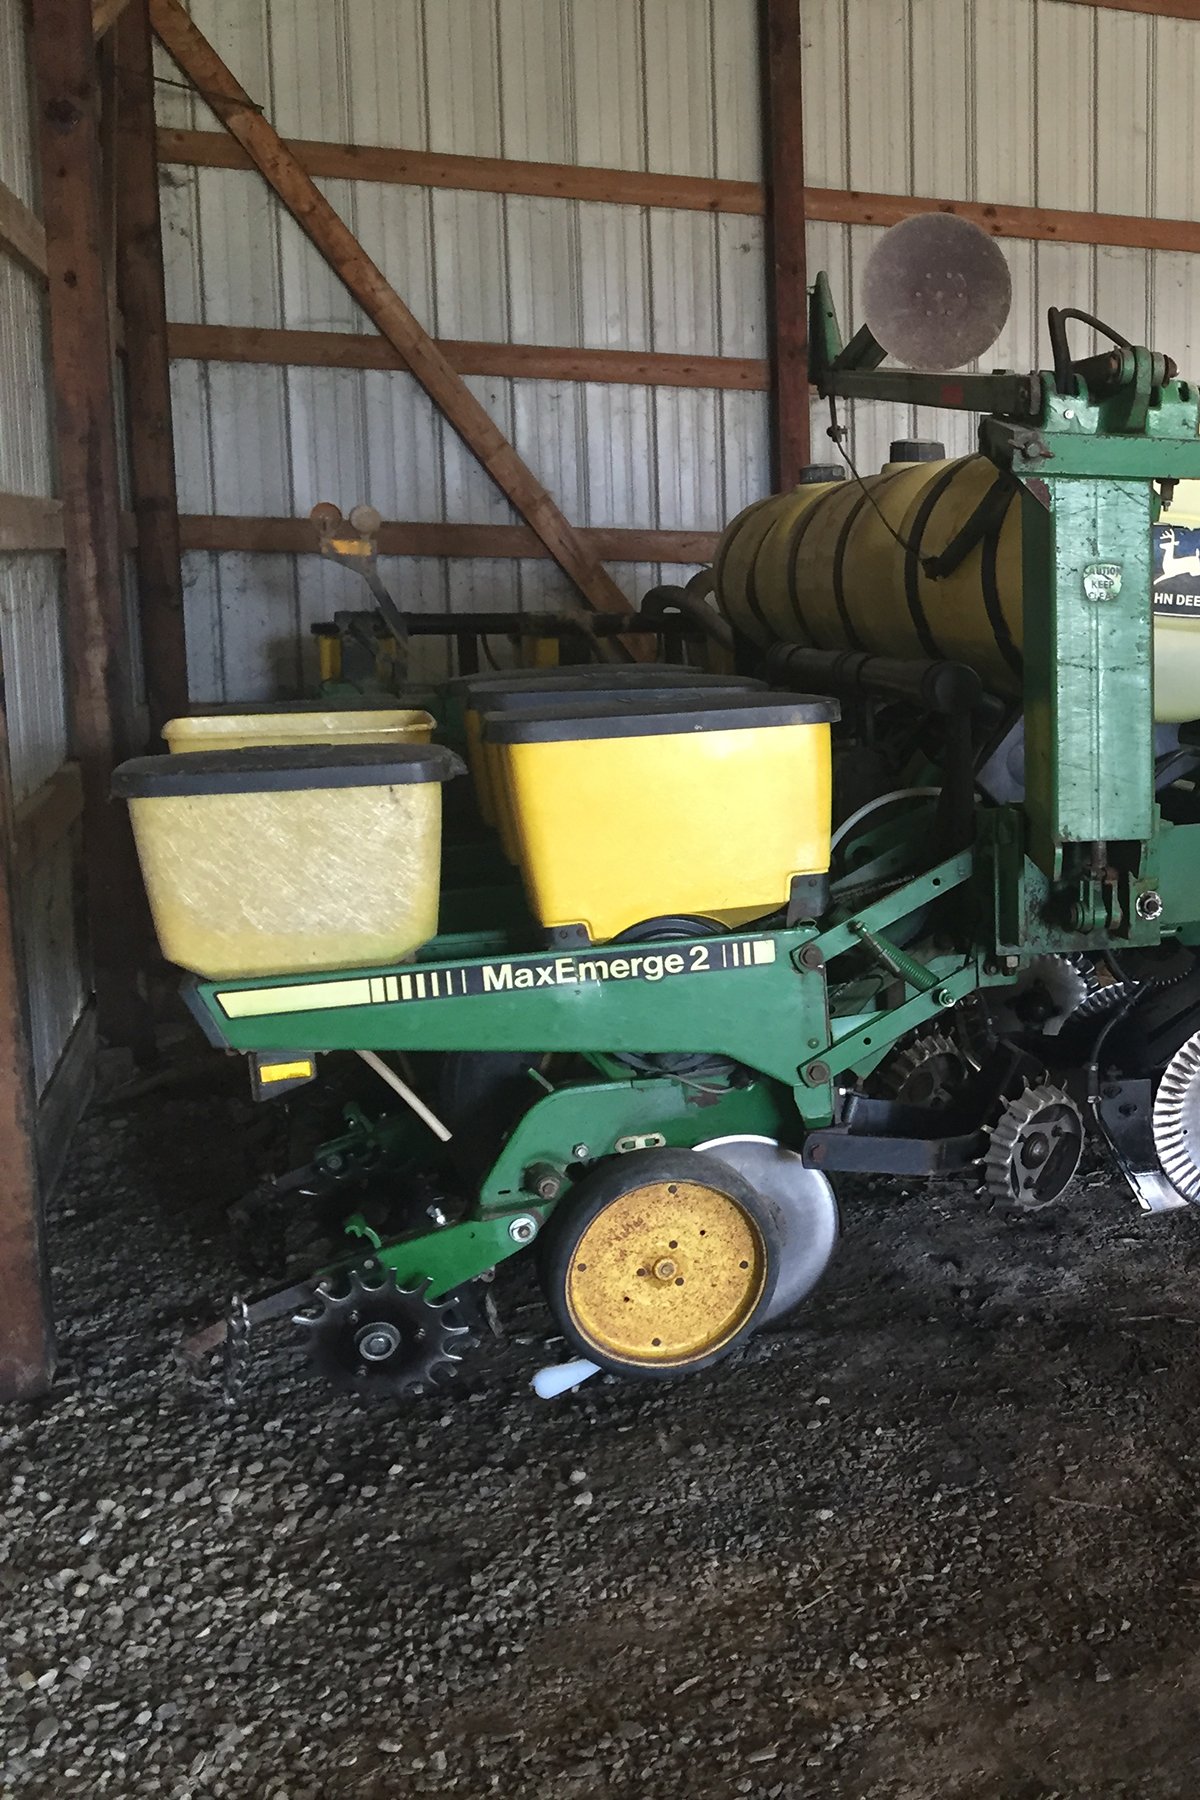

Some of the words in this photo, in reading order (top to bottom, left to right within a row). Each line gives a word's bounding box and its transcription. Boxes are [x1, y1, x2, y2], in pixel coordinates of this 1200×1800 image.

[1091, 580, 1115, 589] KEEP
[1153, 592, 1174, 606] HN
[481, 953, 686, 992] MaxEmerge
[688, 945, 711, 972] 2
